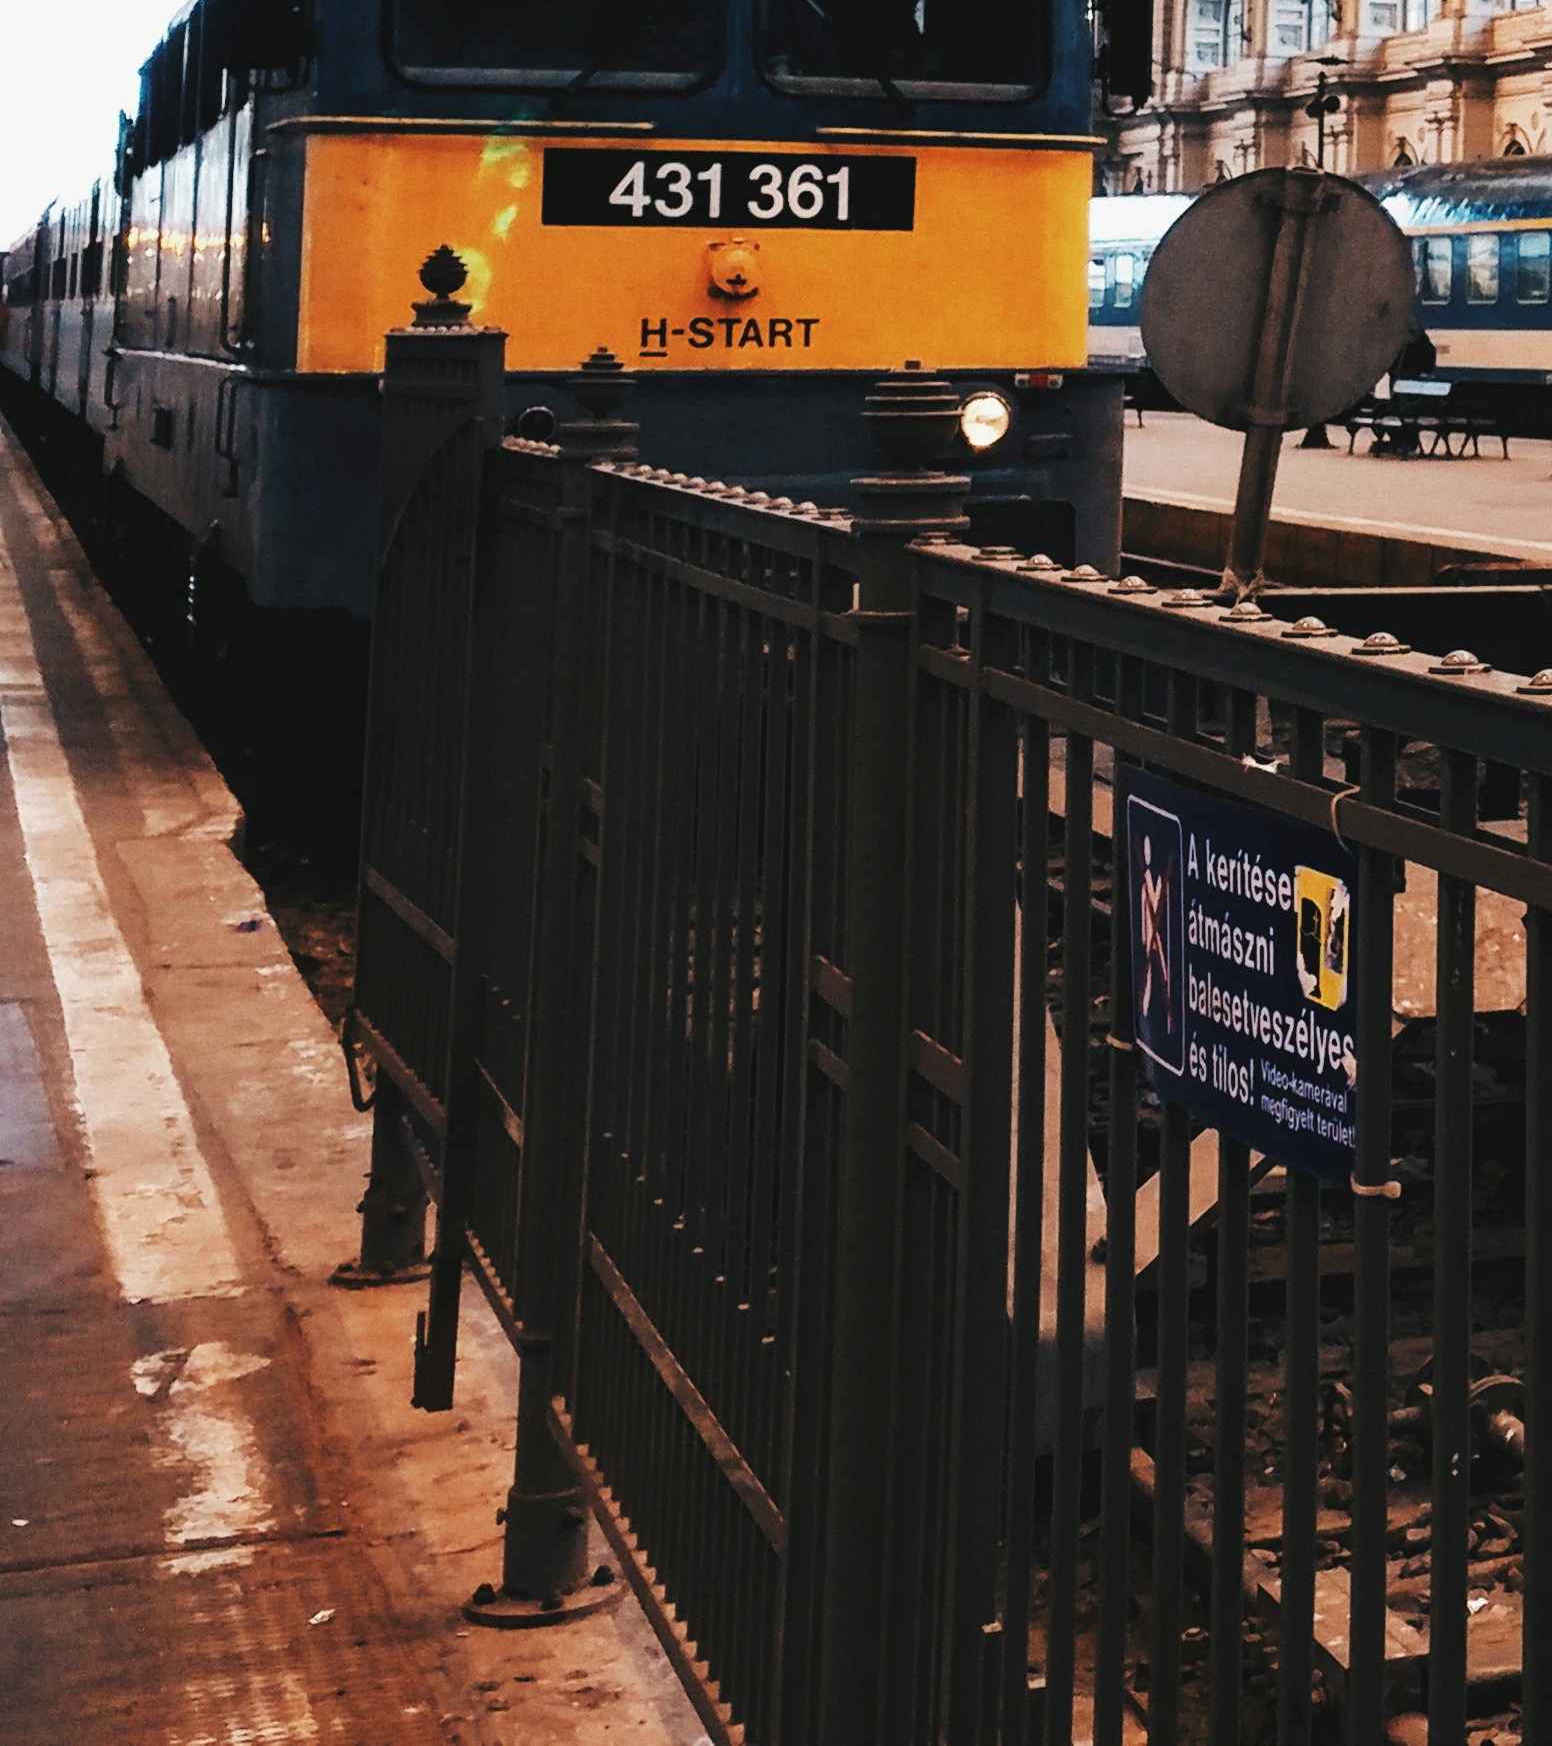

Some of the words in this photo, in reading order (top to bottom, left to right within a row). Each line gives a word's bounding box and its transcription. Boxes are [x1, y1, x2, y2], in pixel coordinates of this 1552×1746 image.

[608, 160, 722, 219] 431
[747, 163, 850, 221] 361
[639, 317, 821, 352] H-START
[1187, 832, 1199, 881] A
[1188, 897, 1275, 976] átmászni
[1189, 962, 1355, 1075] balesetveszélyes
[1189, 1030, 1207, 1083] és
[1212, 1042, 1255, 1106] tilos!
[1260, 1093, 1315, 1132] megfigyelt
